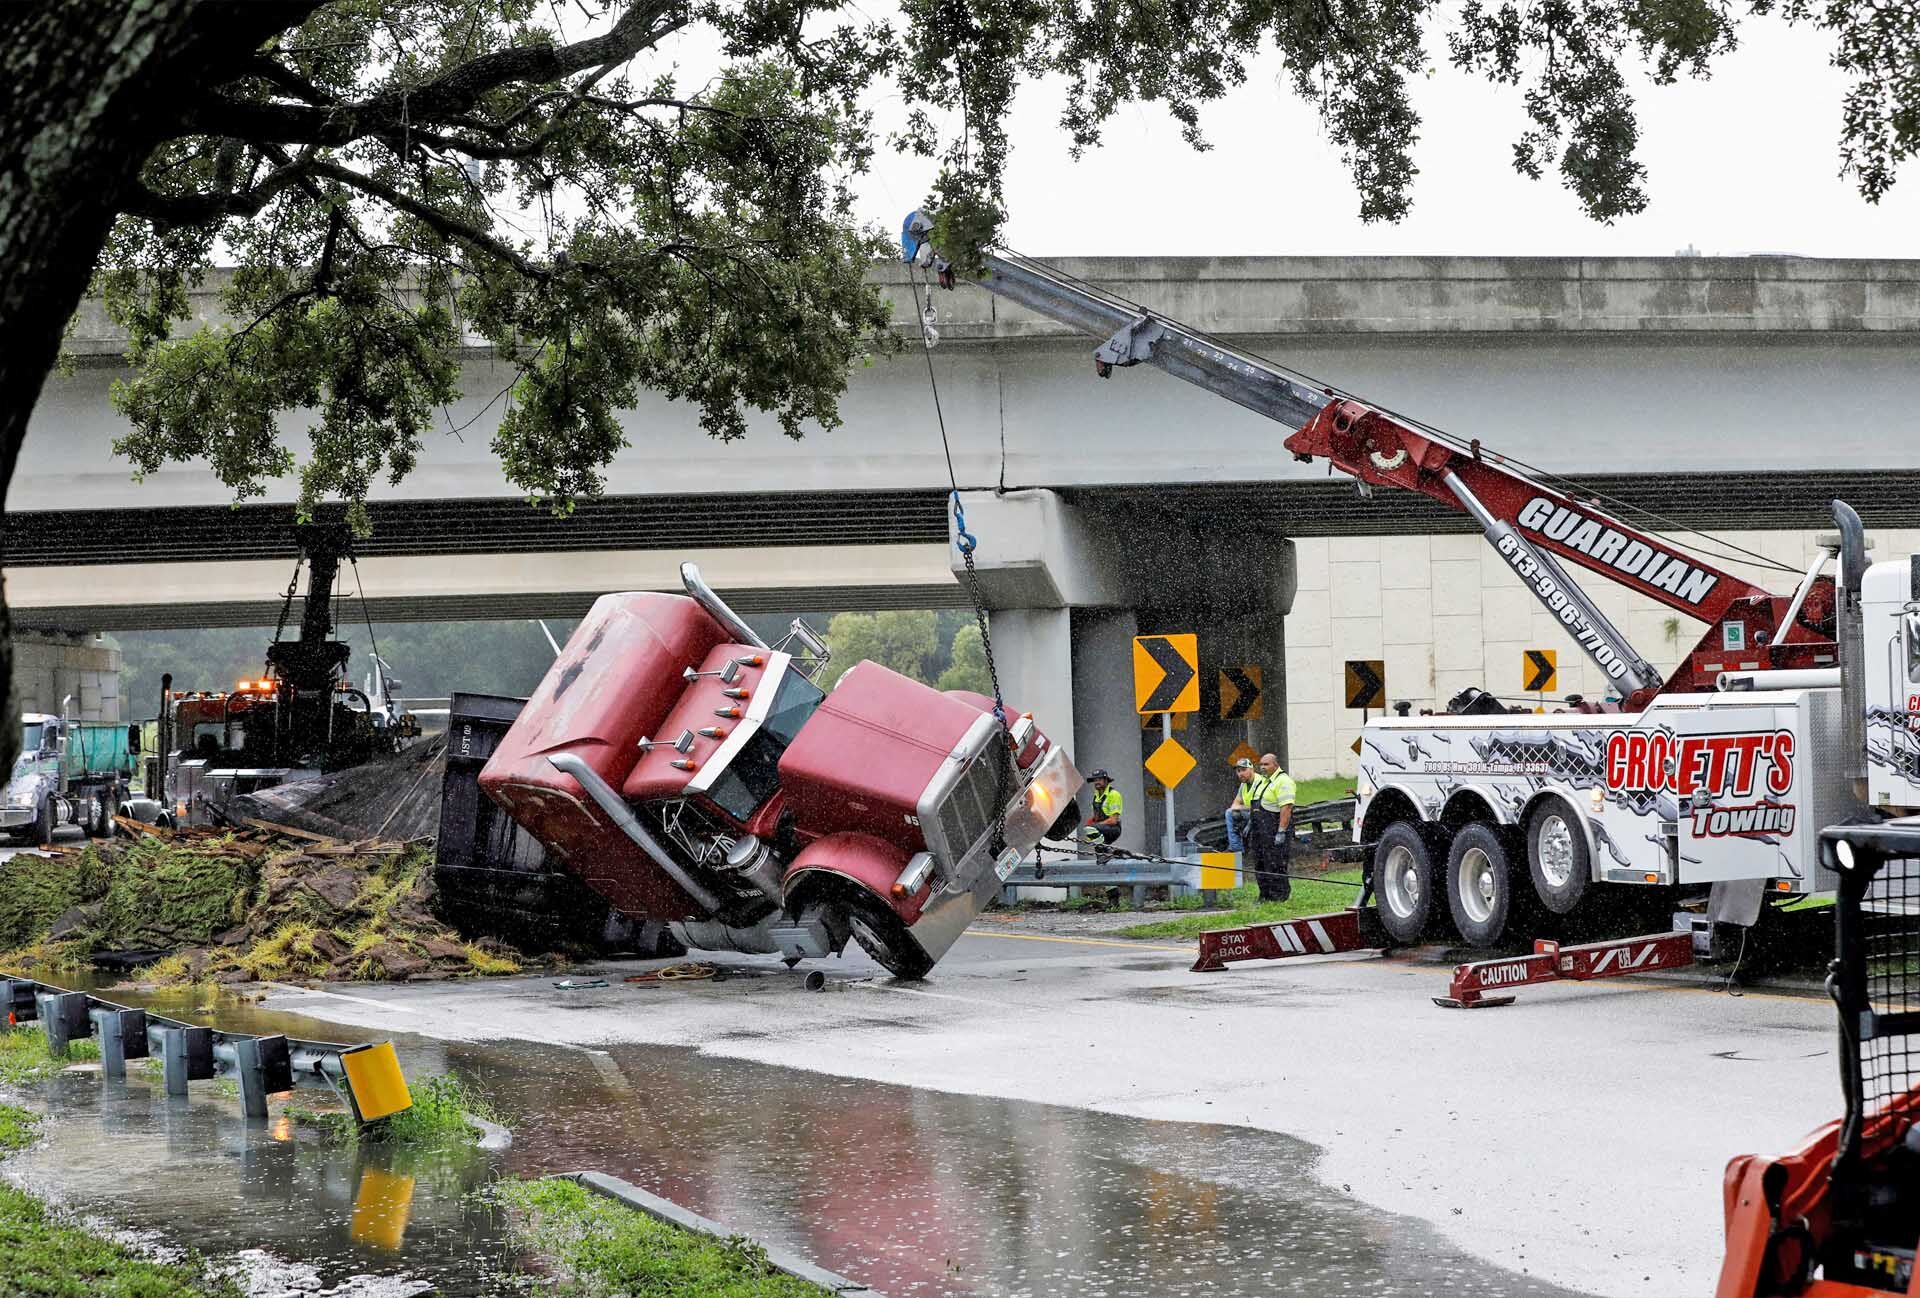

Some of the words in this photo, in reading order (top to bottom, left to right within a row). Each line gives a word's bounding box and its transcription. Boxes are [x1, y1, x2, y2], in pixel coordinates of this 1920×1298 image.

[1517, 497, 1718, 605] GUARDIAN
[1497, 533, 1627, 679] 813-996-7700
[1516, 762, 1524, 772] FL
[1525, 762, 1549, 773] 33637
[1693, 804, 1793, 835] Towing
[1219, 945, 1250, 958] BACK
[1221, 934, 1246, 945] STAY
[1480, 962, 1528, 986] CAUTION
